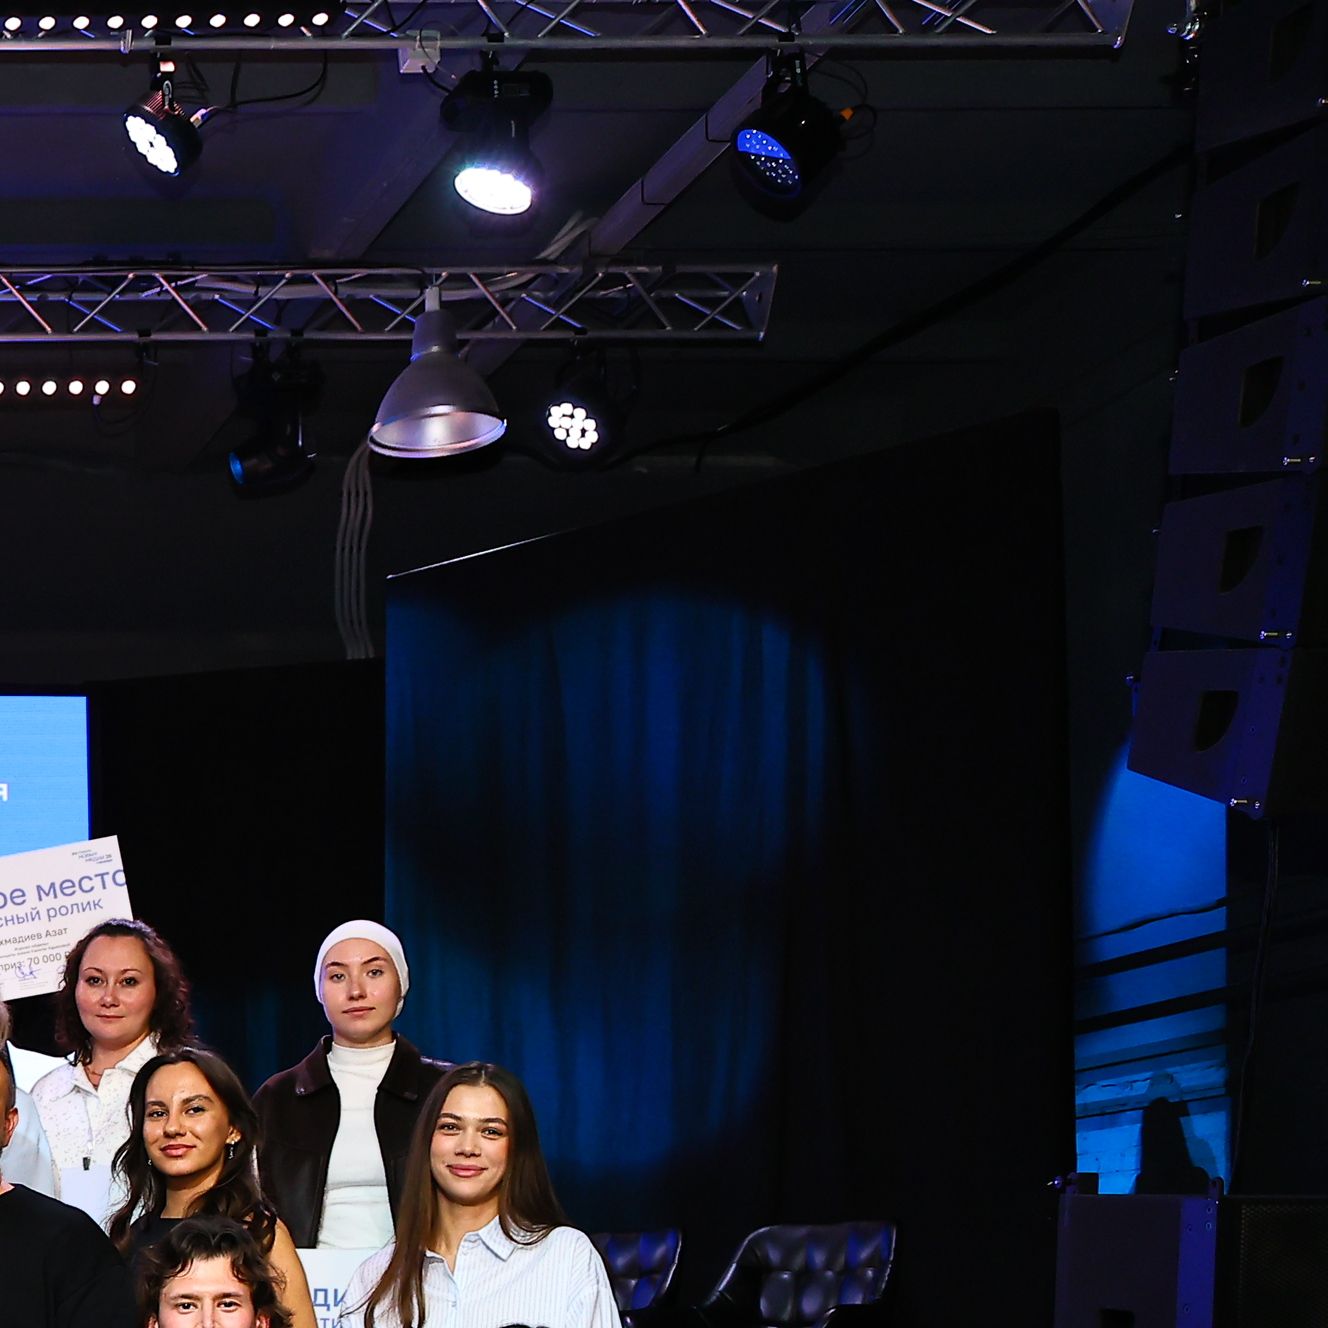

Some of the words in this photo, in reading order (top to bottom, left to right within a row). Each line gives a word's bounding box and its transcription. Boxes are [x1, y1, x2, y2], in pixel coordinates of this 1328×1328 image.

[36, 869, 126, 902] место
[46, 898, 104, 921] ролик
[44, 928, 68, 939] Азат
[27, 956, 40, 966] 70
[42, 952, 62, 964] 000
